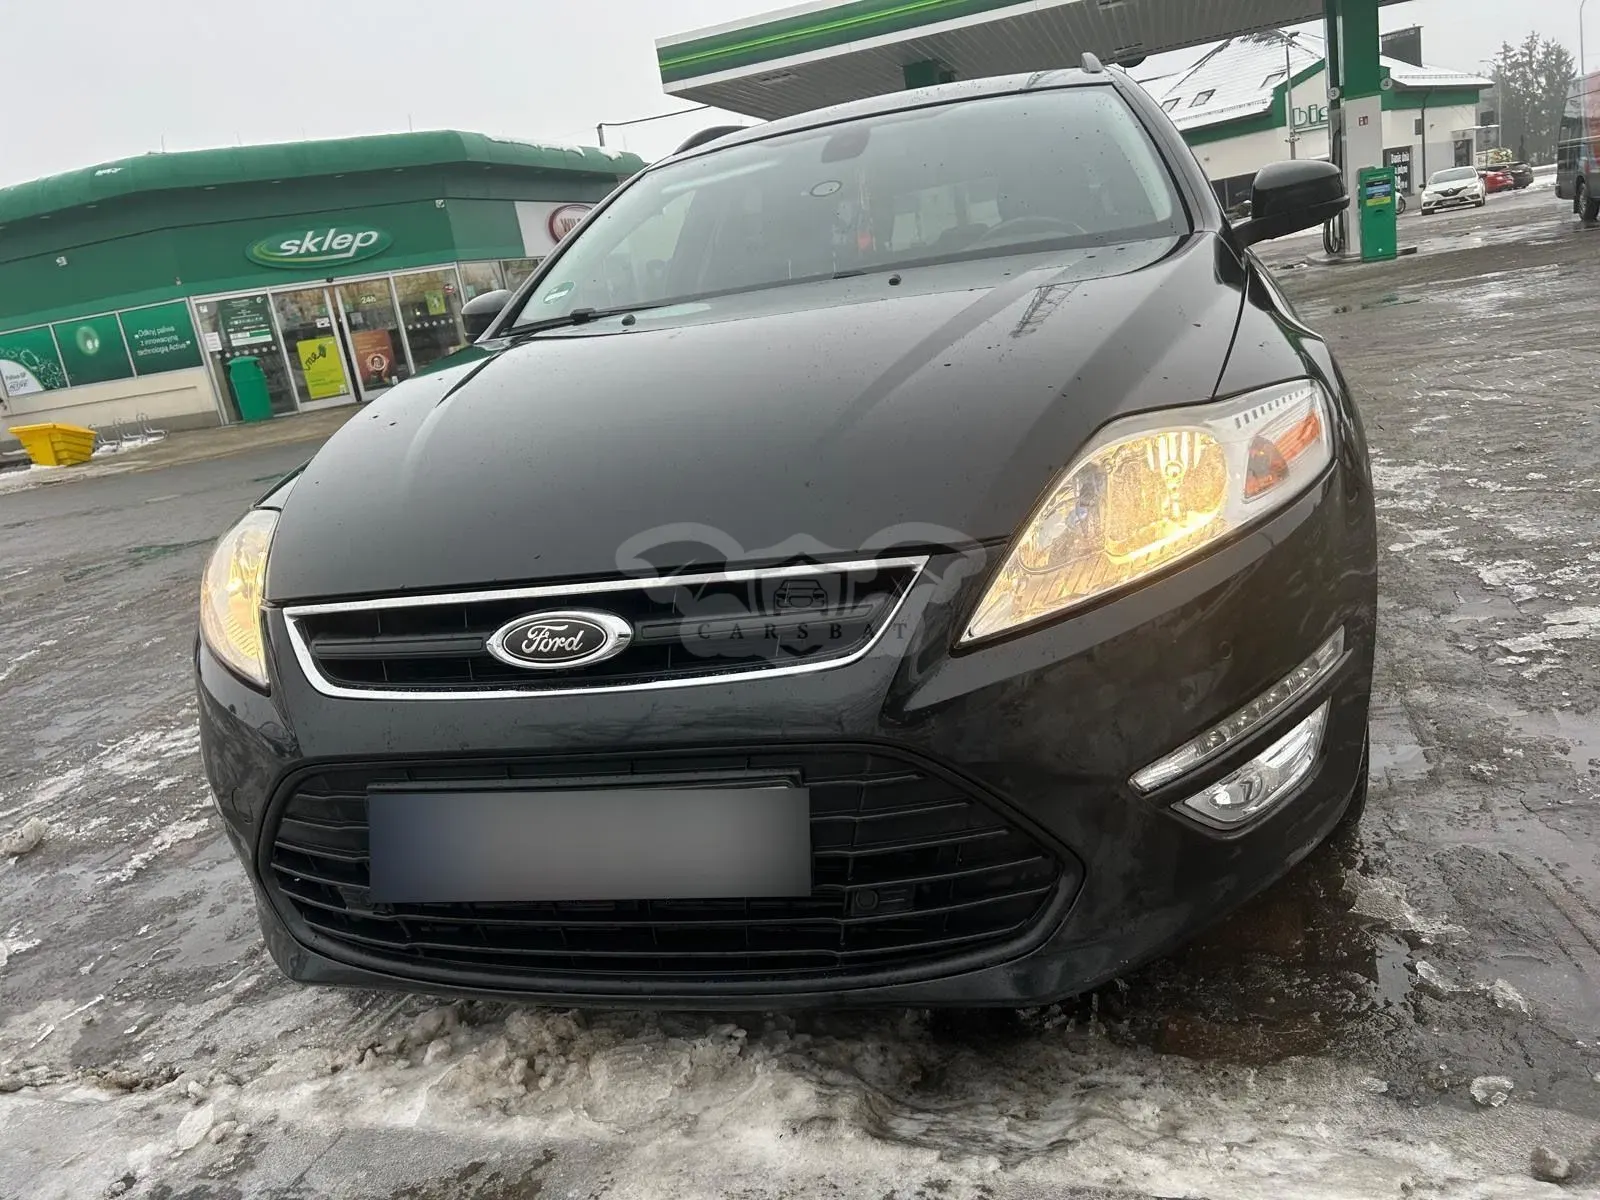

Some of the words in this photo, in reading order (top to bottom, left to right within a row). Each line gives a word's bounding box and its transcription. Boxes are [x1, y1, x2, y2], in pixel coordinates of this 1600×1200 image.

[280, 228, 379, 257] sklep
[361, 296, 377, 304] 24h
[521, 624, 585, 654] Ford
